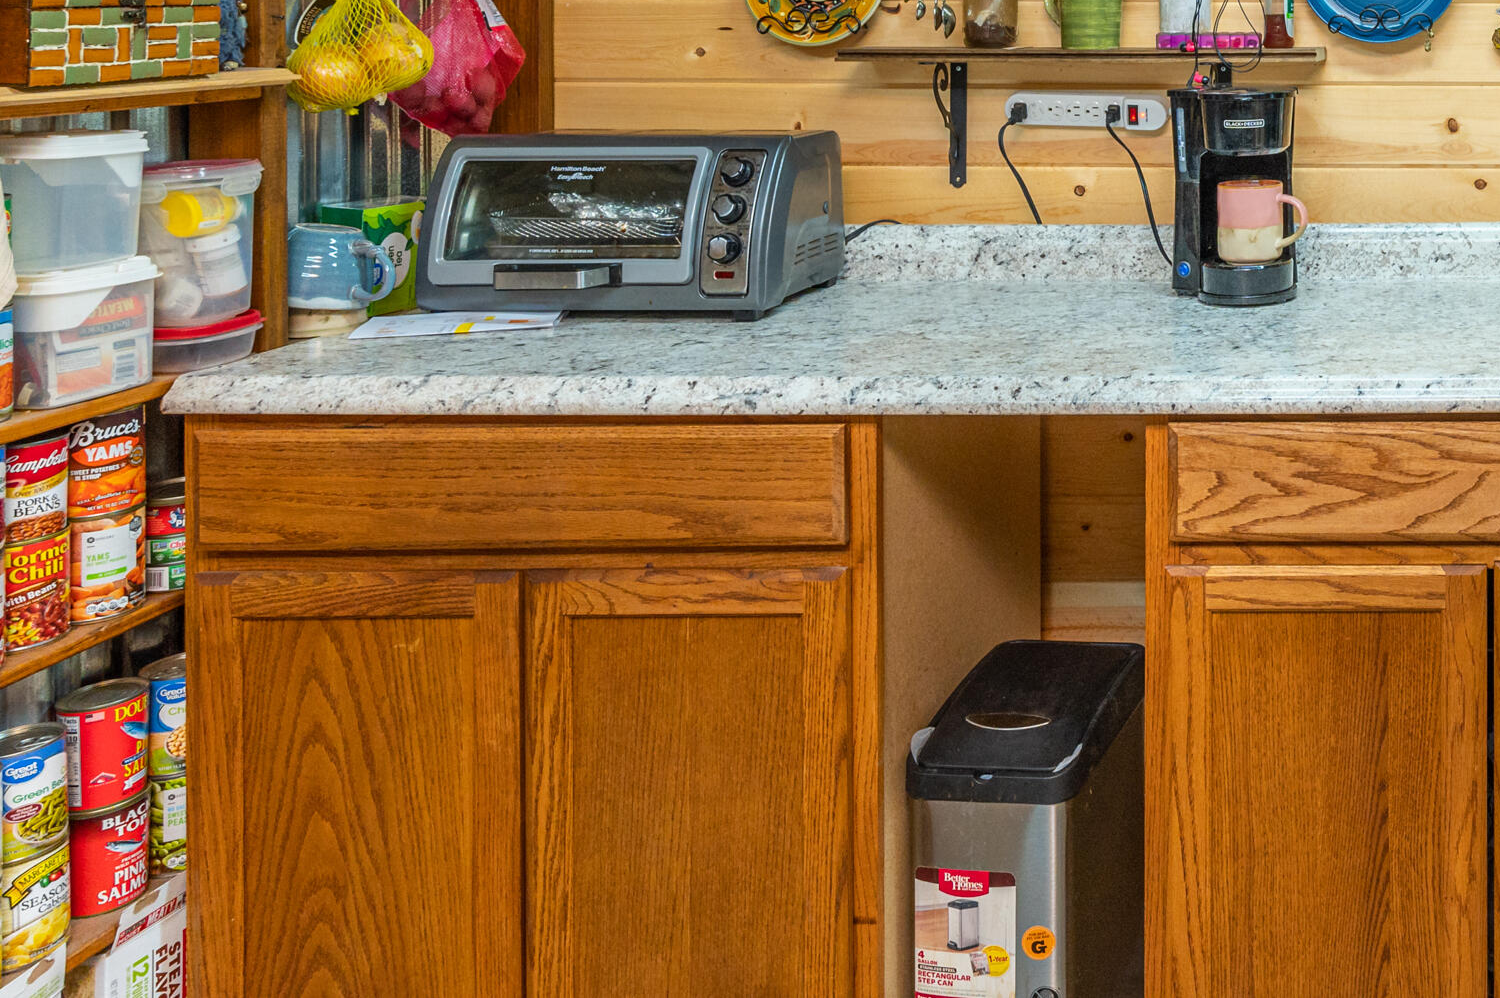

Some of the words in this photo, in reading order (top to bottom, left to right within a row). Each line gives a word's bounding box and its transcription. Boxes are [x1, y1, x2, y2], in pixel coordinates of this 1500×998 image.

[69, 418, 141, 449] Bruce's
[84, 440, 133, 463] YAMS
[70, 468, 90, 477] SWEET
[13, 499, 61, 518] BEANS
[17, 494, 50, 508] PORK
[5, 542, 69, 568] orme
[86, 552, 111, 562] YAMS
[9, 556, 64, 584] Chili
[26, 582, 57, 600] Beans
[5, 761, 38, 777] Great
[13, 768, 38, 780] Value
[12, 785, 50, 804] Green
[101, 800, 148, 831] BLAC
[114, 858, 146, 886] PINK
[944, 872, 970, 882] Better
[951, 881, 984, 891] Homes
[917, 950, 925, 959] 4
[1031, 939, 1048, 954] G
[988, 955, 1008, 963] 1-Year
[132, 954, 149, 984] 12
[168, 940, 181, 998] STEA
[917, 971, 971, 982] RECTANGULAR
[917, 977, 936, 985] STEP
[937, 979, 954, 987] CAN
